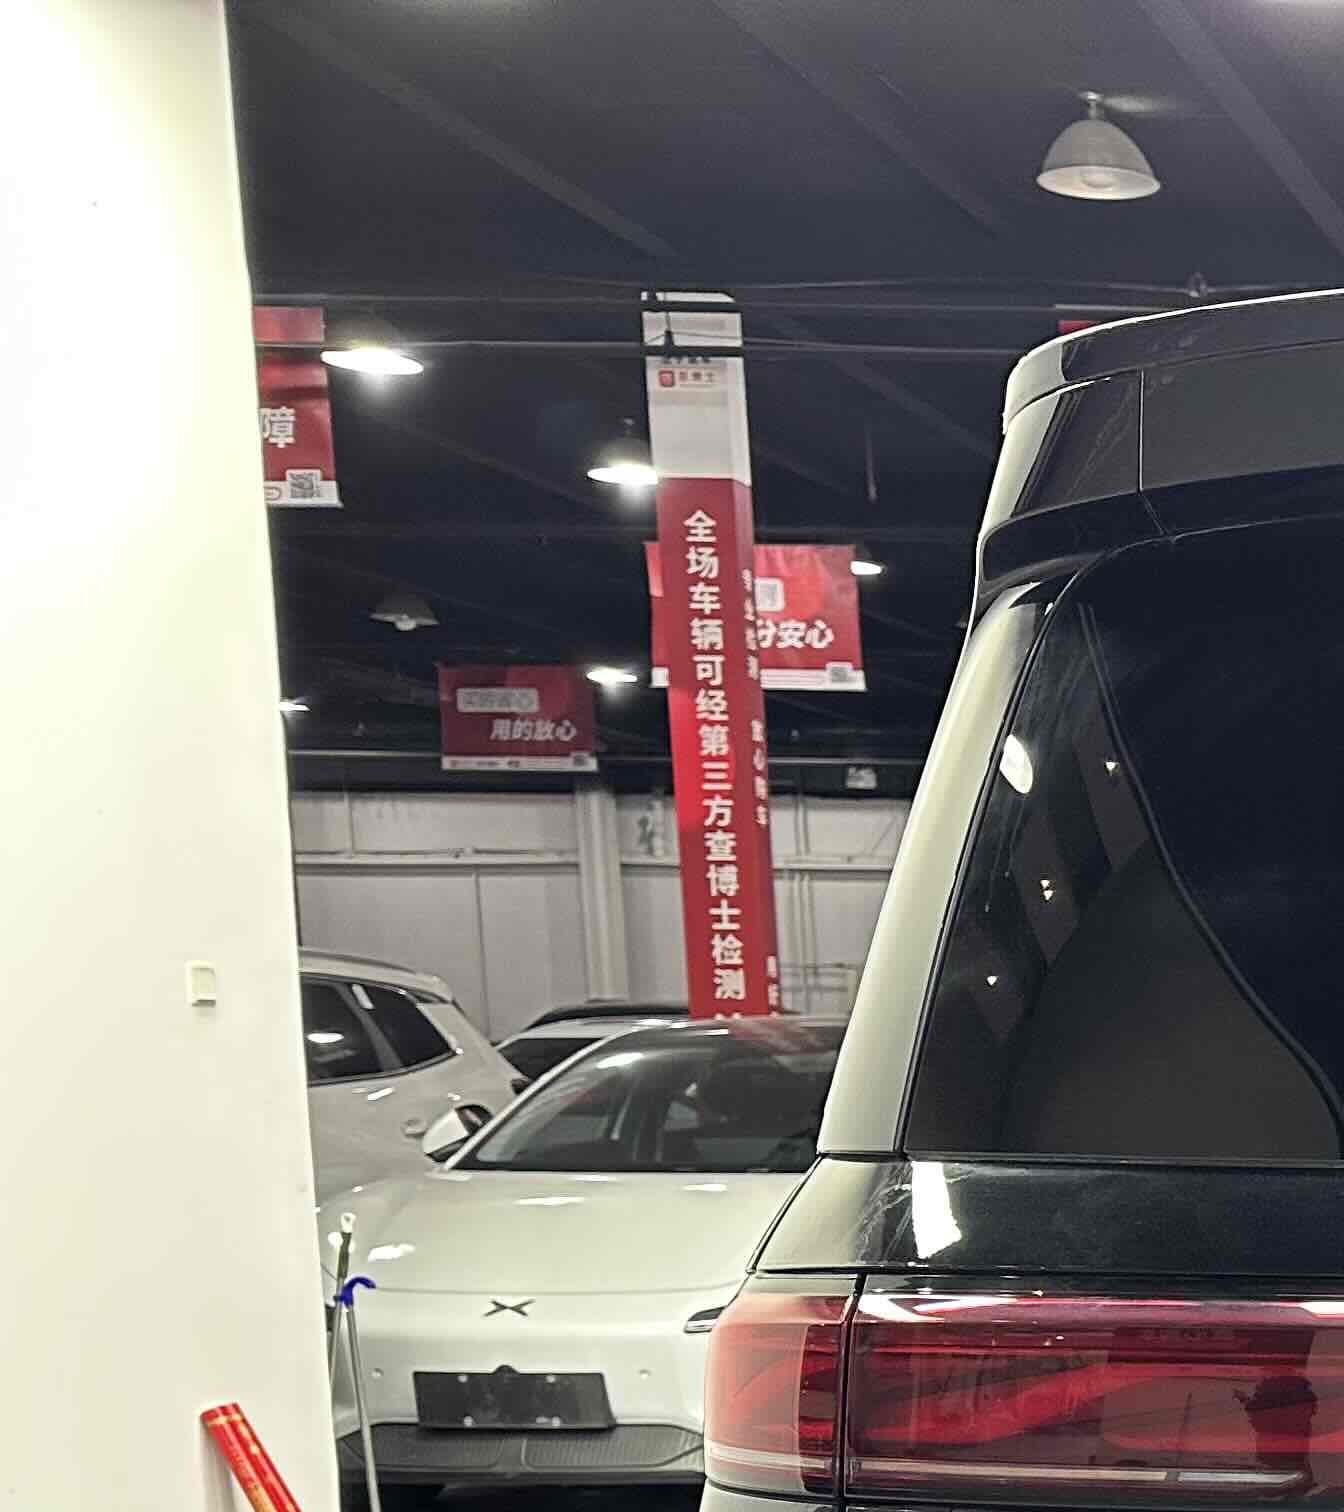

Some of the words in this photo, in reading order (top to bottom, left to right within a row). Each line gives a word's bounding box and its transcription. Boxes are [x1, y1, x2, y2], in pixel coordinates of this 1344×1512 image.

[683, 509, 746, 1019] 全场车辆可经第三方查博士检测
